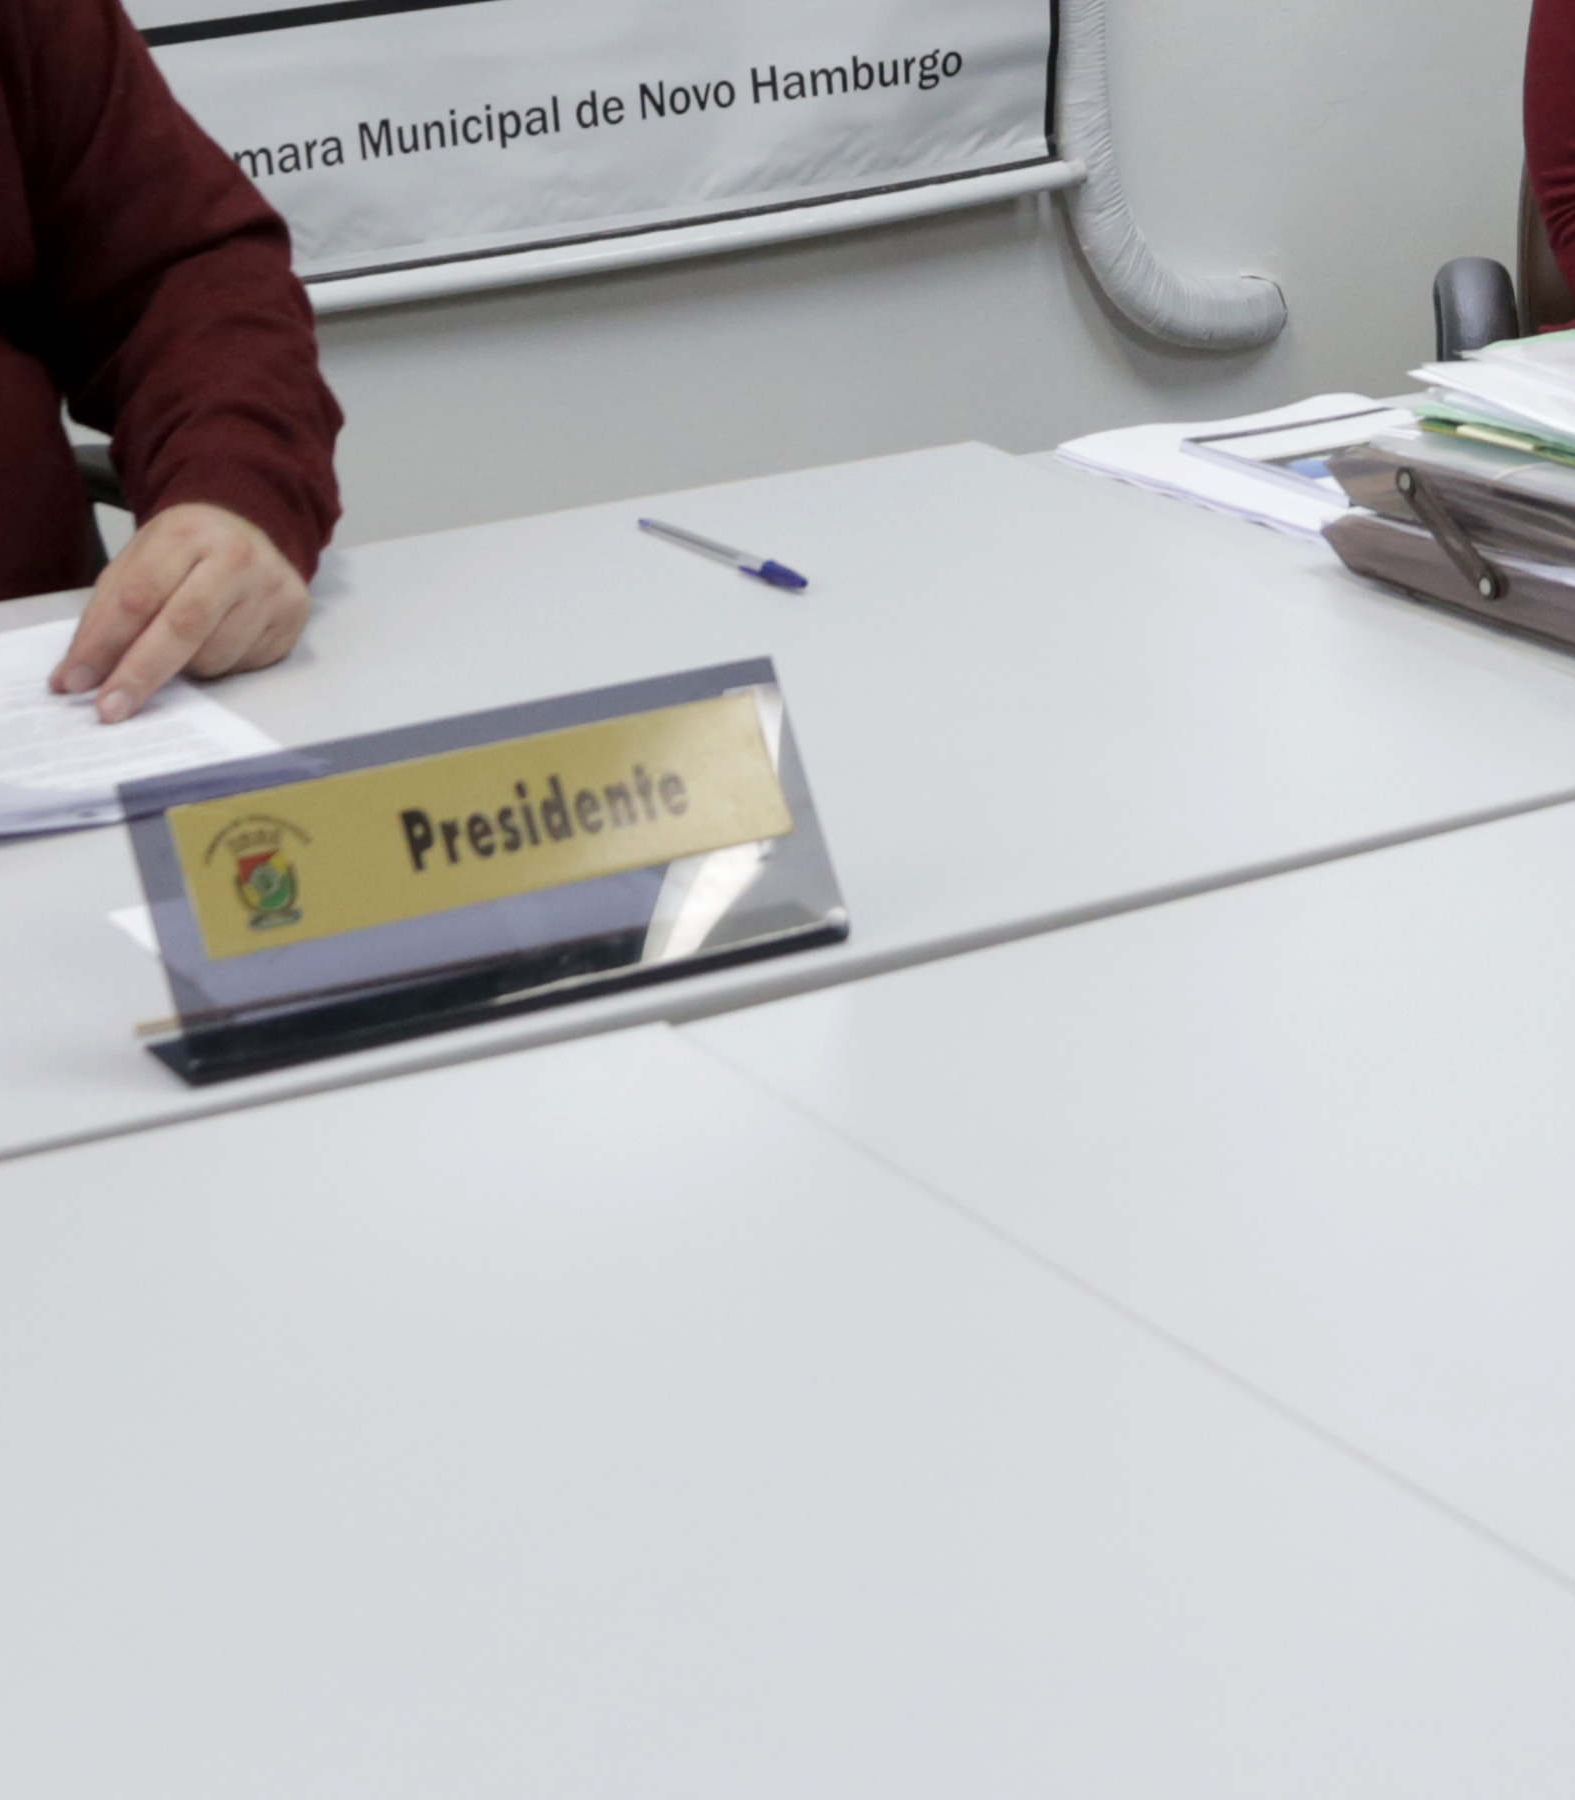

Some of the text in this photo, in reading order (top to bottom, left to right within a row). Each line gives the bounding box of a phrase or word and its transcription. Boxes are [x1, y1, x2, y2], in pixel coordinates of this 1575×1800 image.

[232, 47, 964, 178] mara Municipal de Novo Hamburgo
[398, 764, 691, 874] Presidente
